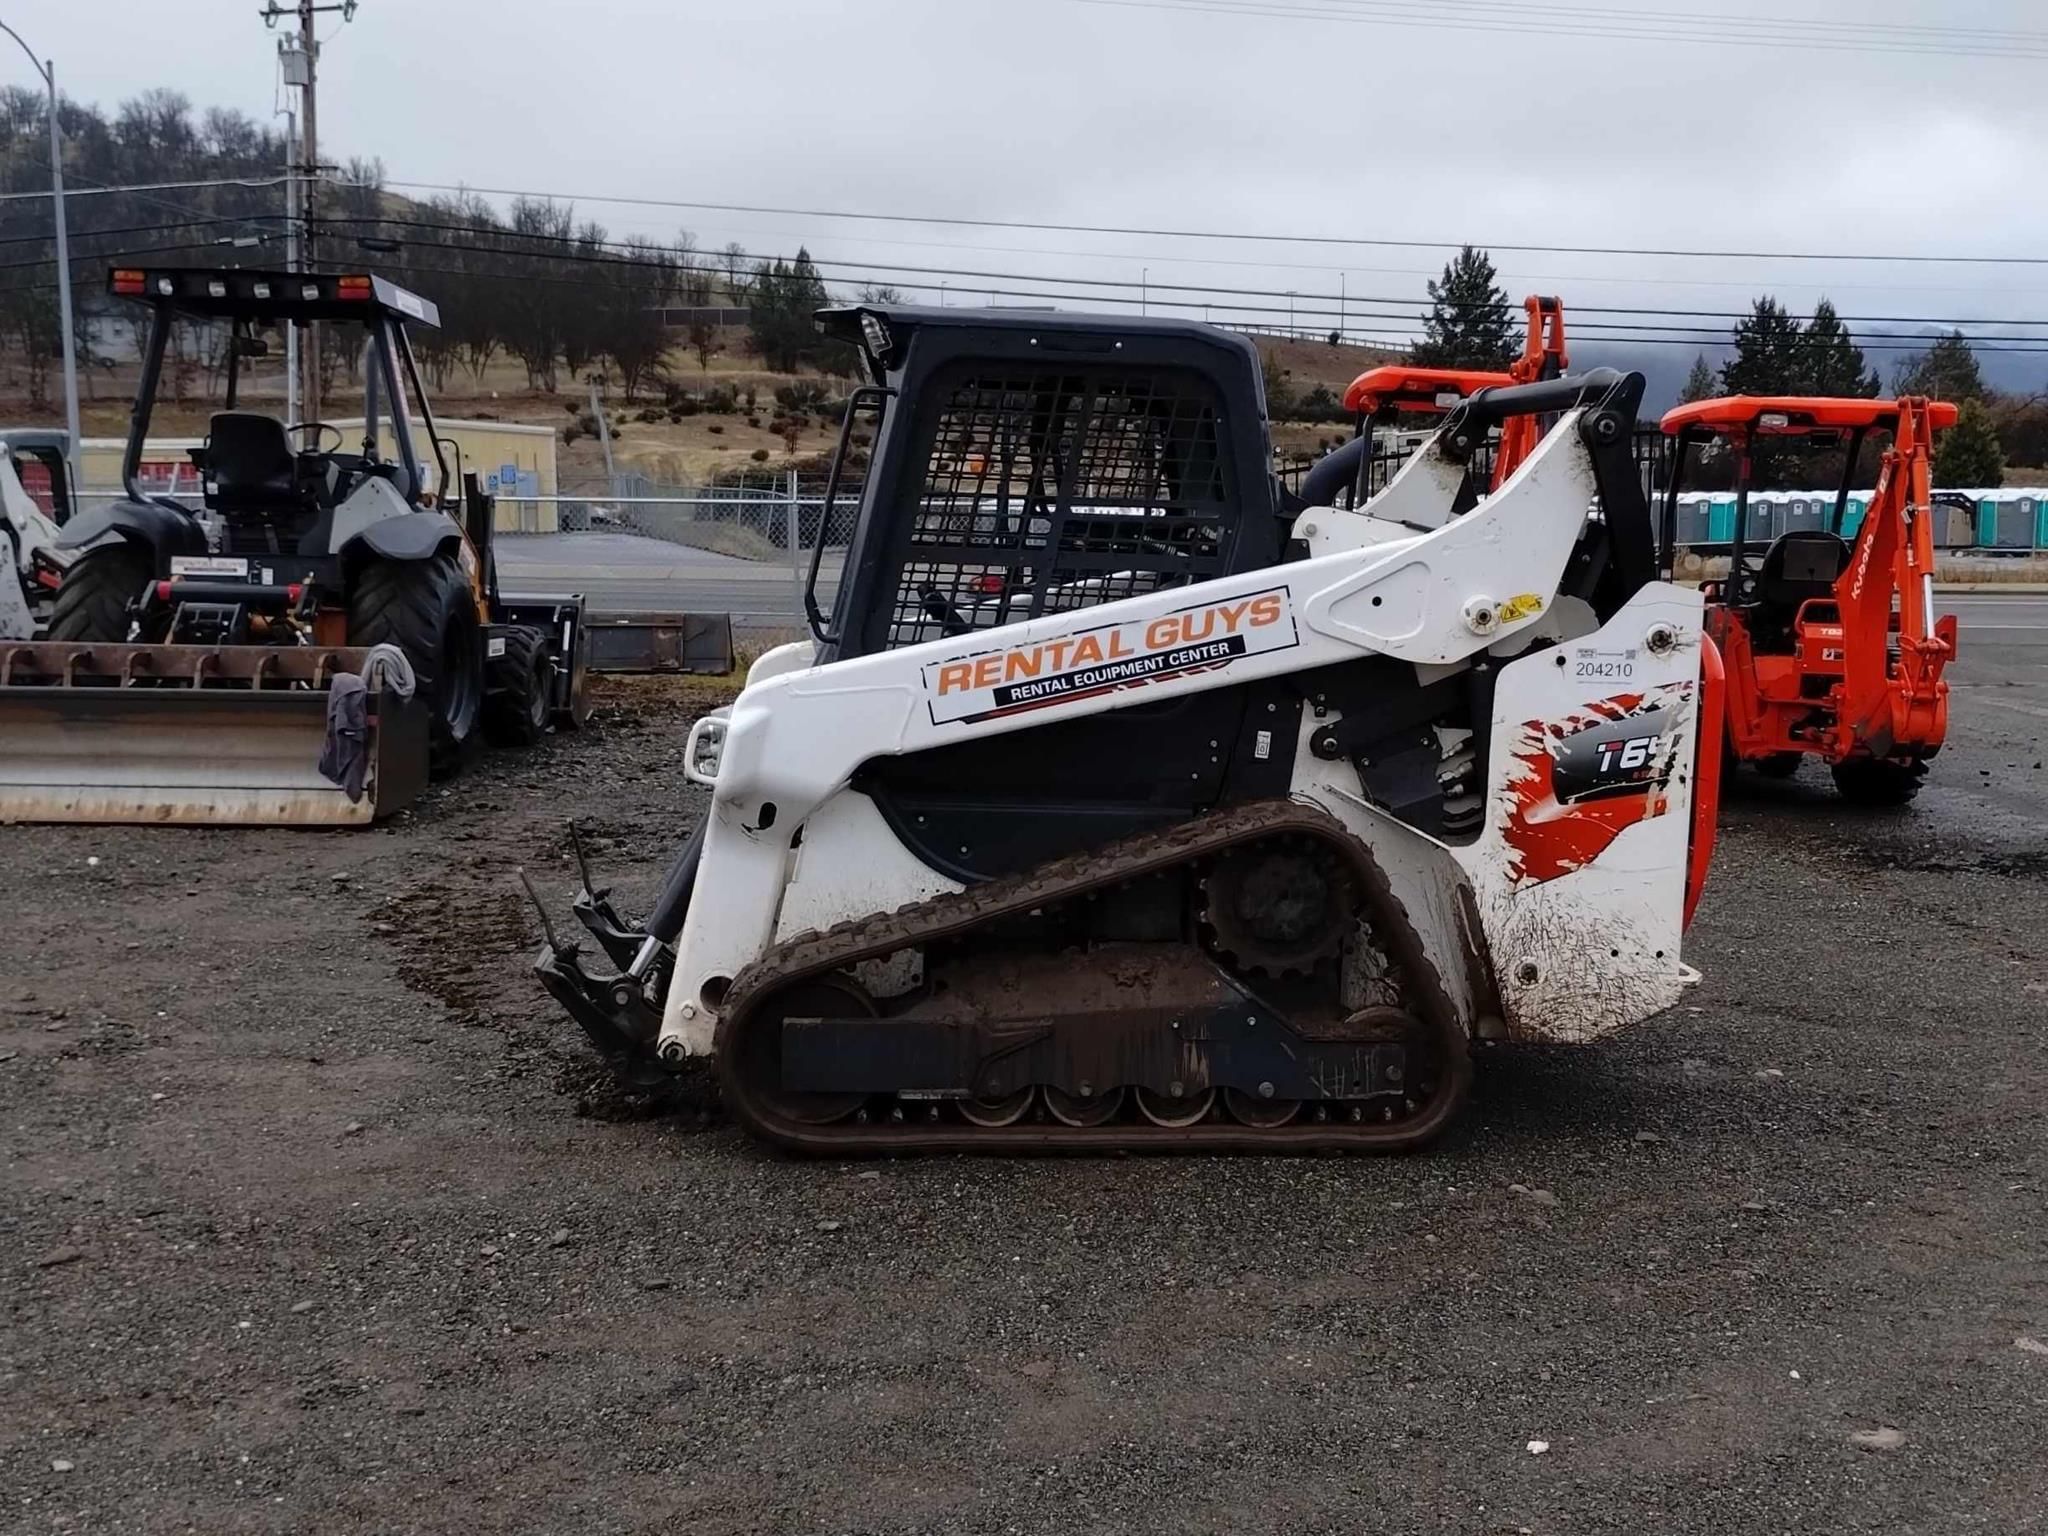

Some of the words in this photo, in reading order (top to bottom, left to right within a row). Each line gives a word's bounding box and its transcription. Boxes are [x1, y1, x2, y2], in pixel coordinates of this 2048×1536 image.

[1851, 534, 1873, 600] Kubota
[937, 629, 1135, 696] RENTAL
[1145, 595, 1282, 650] GUYS
[1011, 679, 1071, 702] RENTAL
[1074, 656, 1165, 689] EQUIPMENT
[1168, 642, 1231, 667] CENTER
[1576, 662, 1633, 677] 204210
